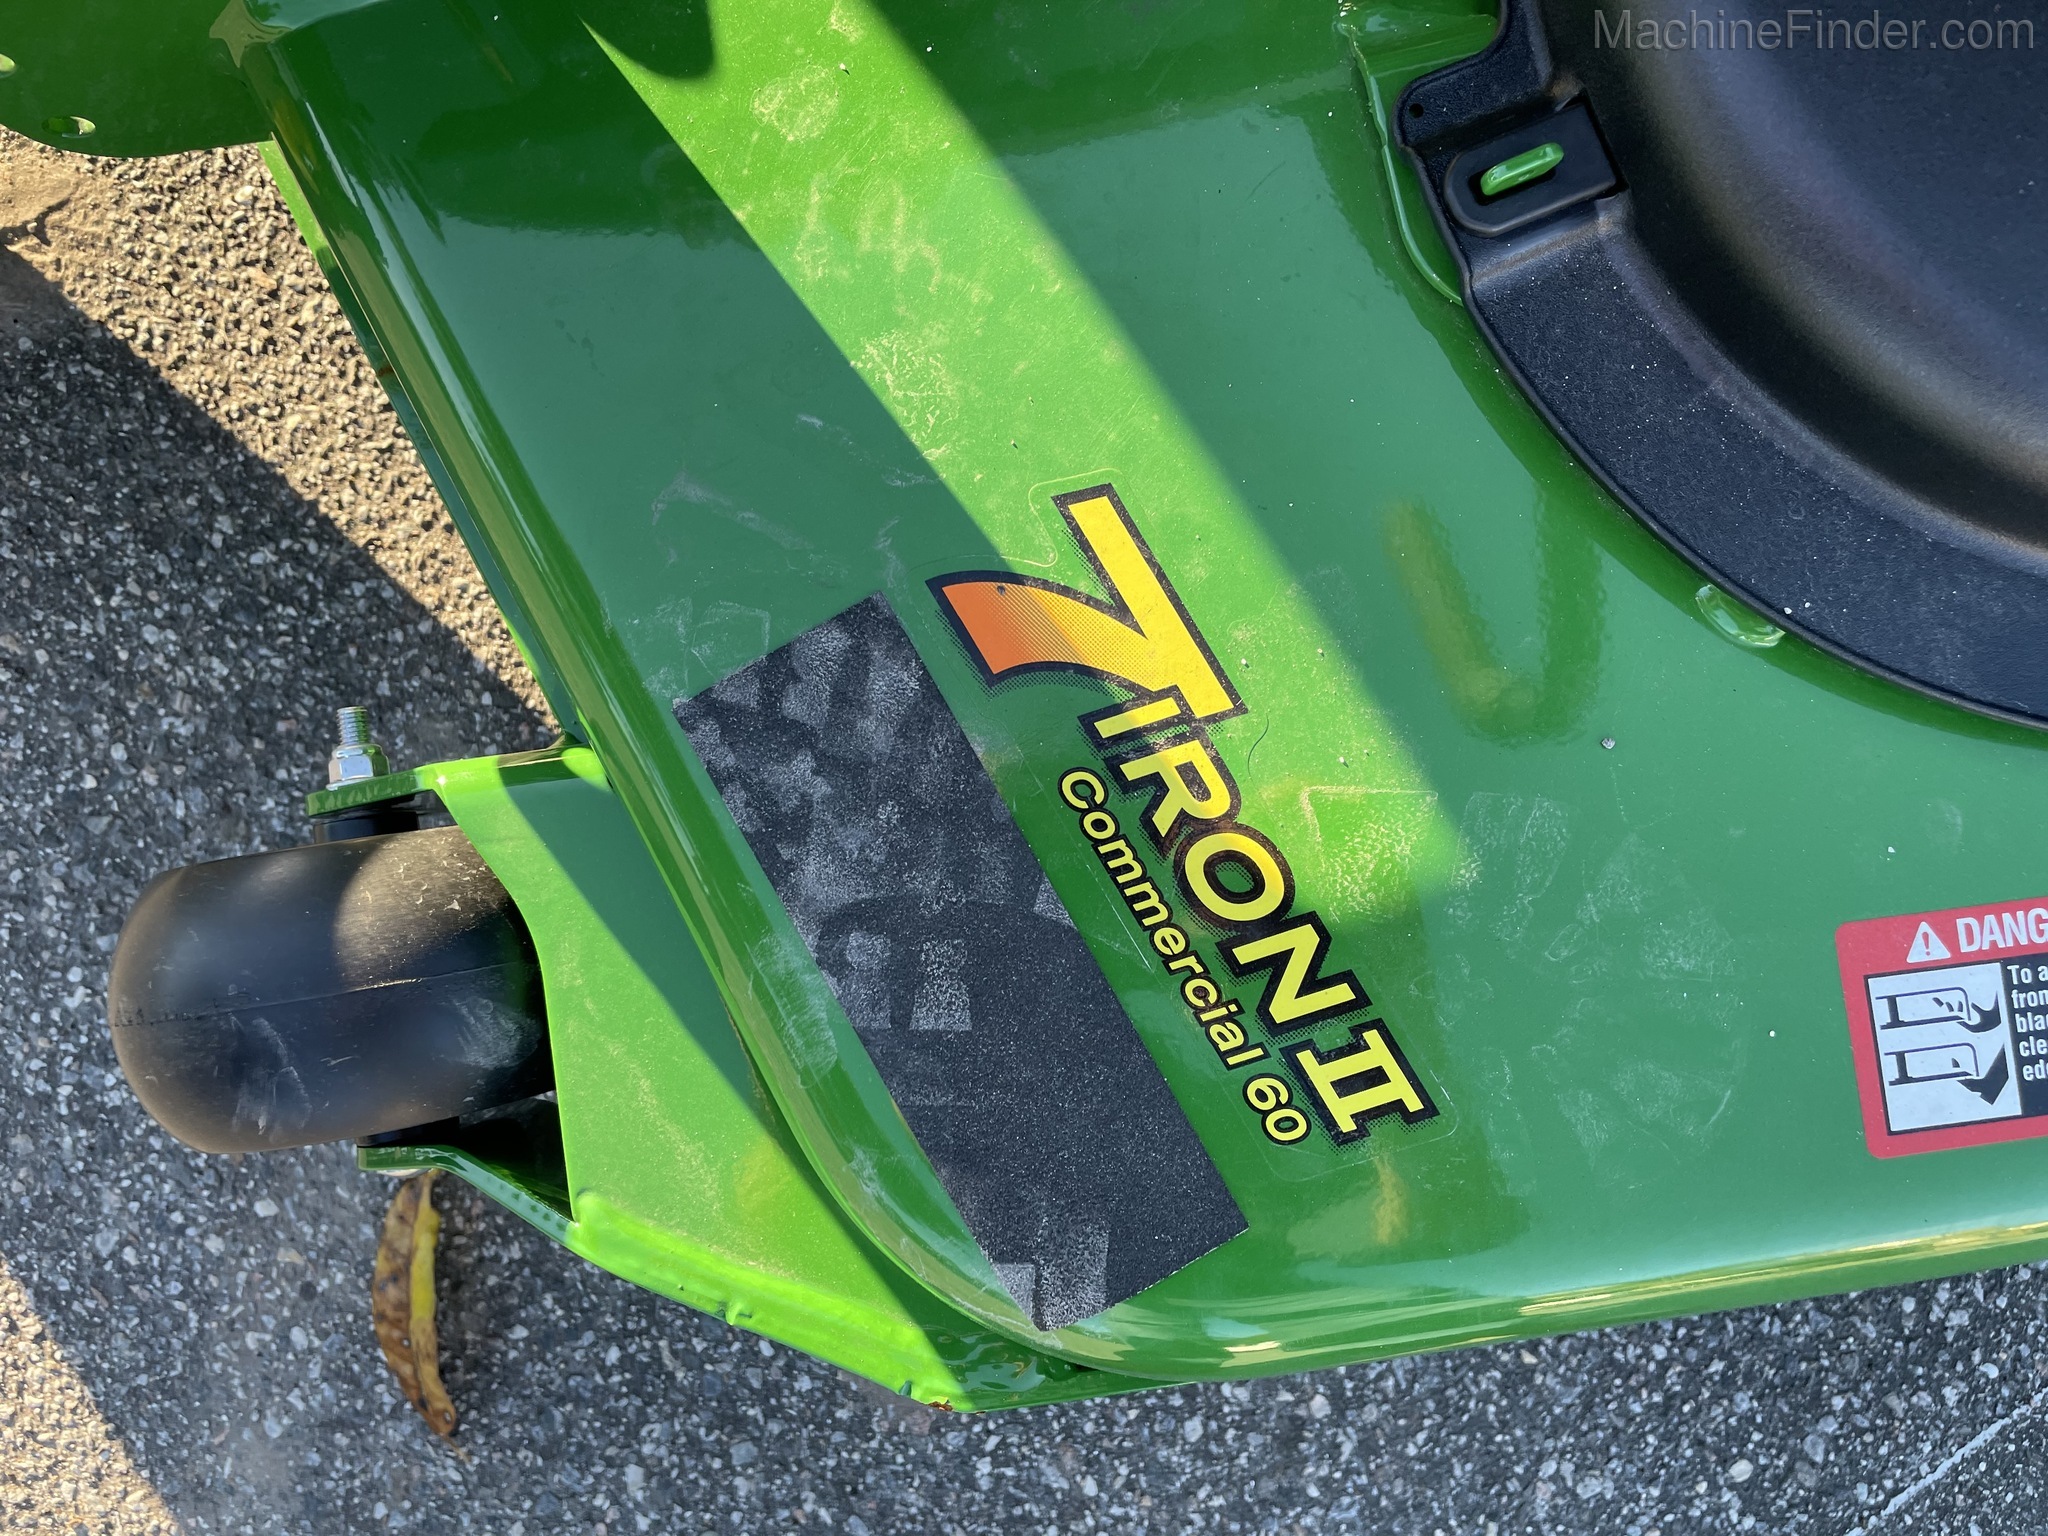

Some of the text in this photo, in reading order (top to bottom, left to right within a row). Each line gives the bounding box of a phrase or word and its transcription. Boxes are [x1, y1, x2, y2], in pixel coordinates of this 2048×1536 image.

[1060, 771, 1308, 1142] Commercial 60
[2006, 964, 2033, 985] To
[2015, 1011, 2048, 1033] bla
[2022, 1059, 2048, 1081] ed
